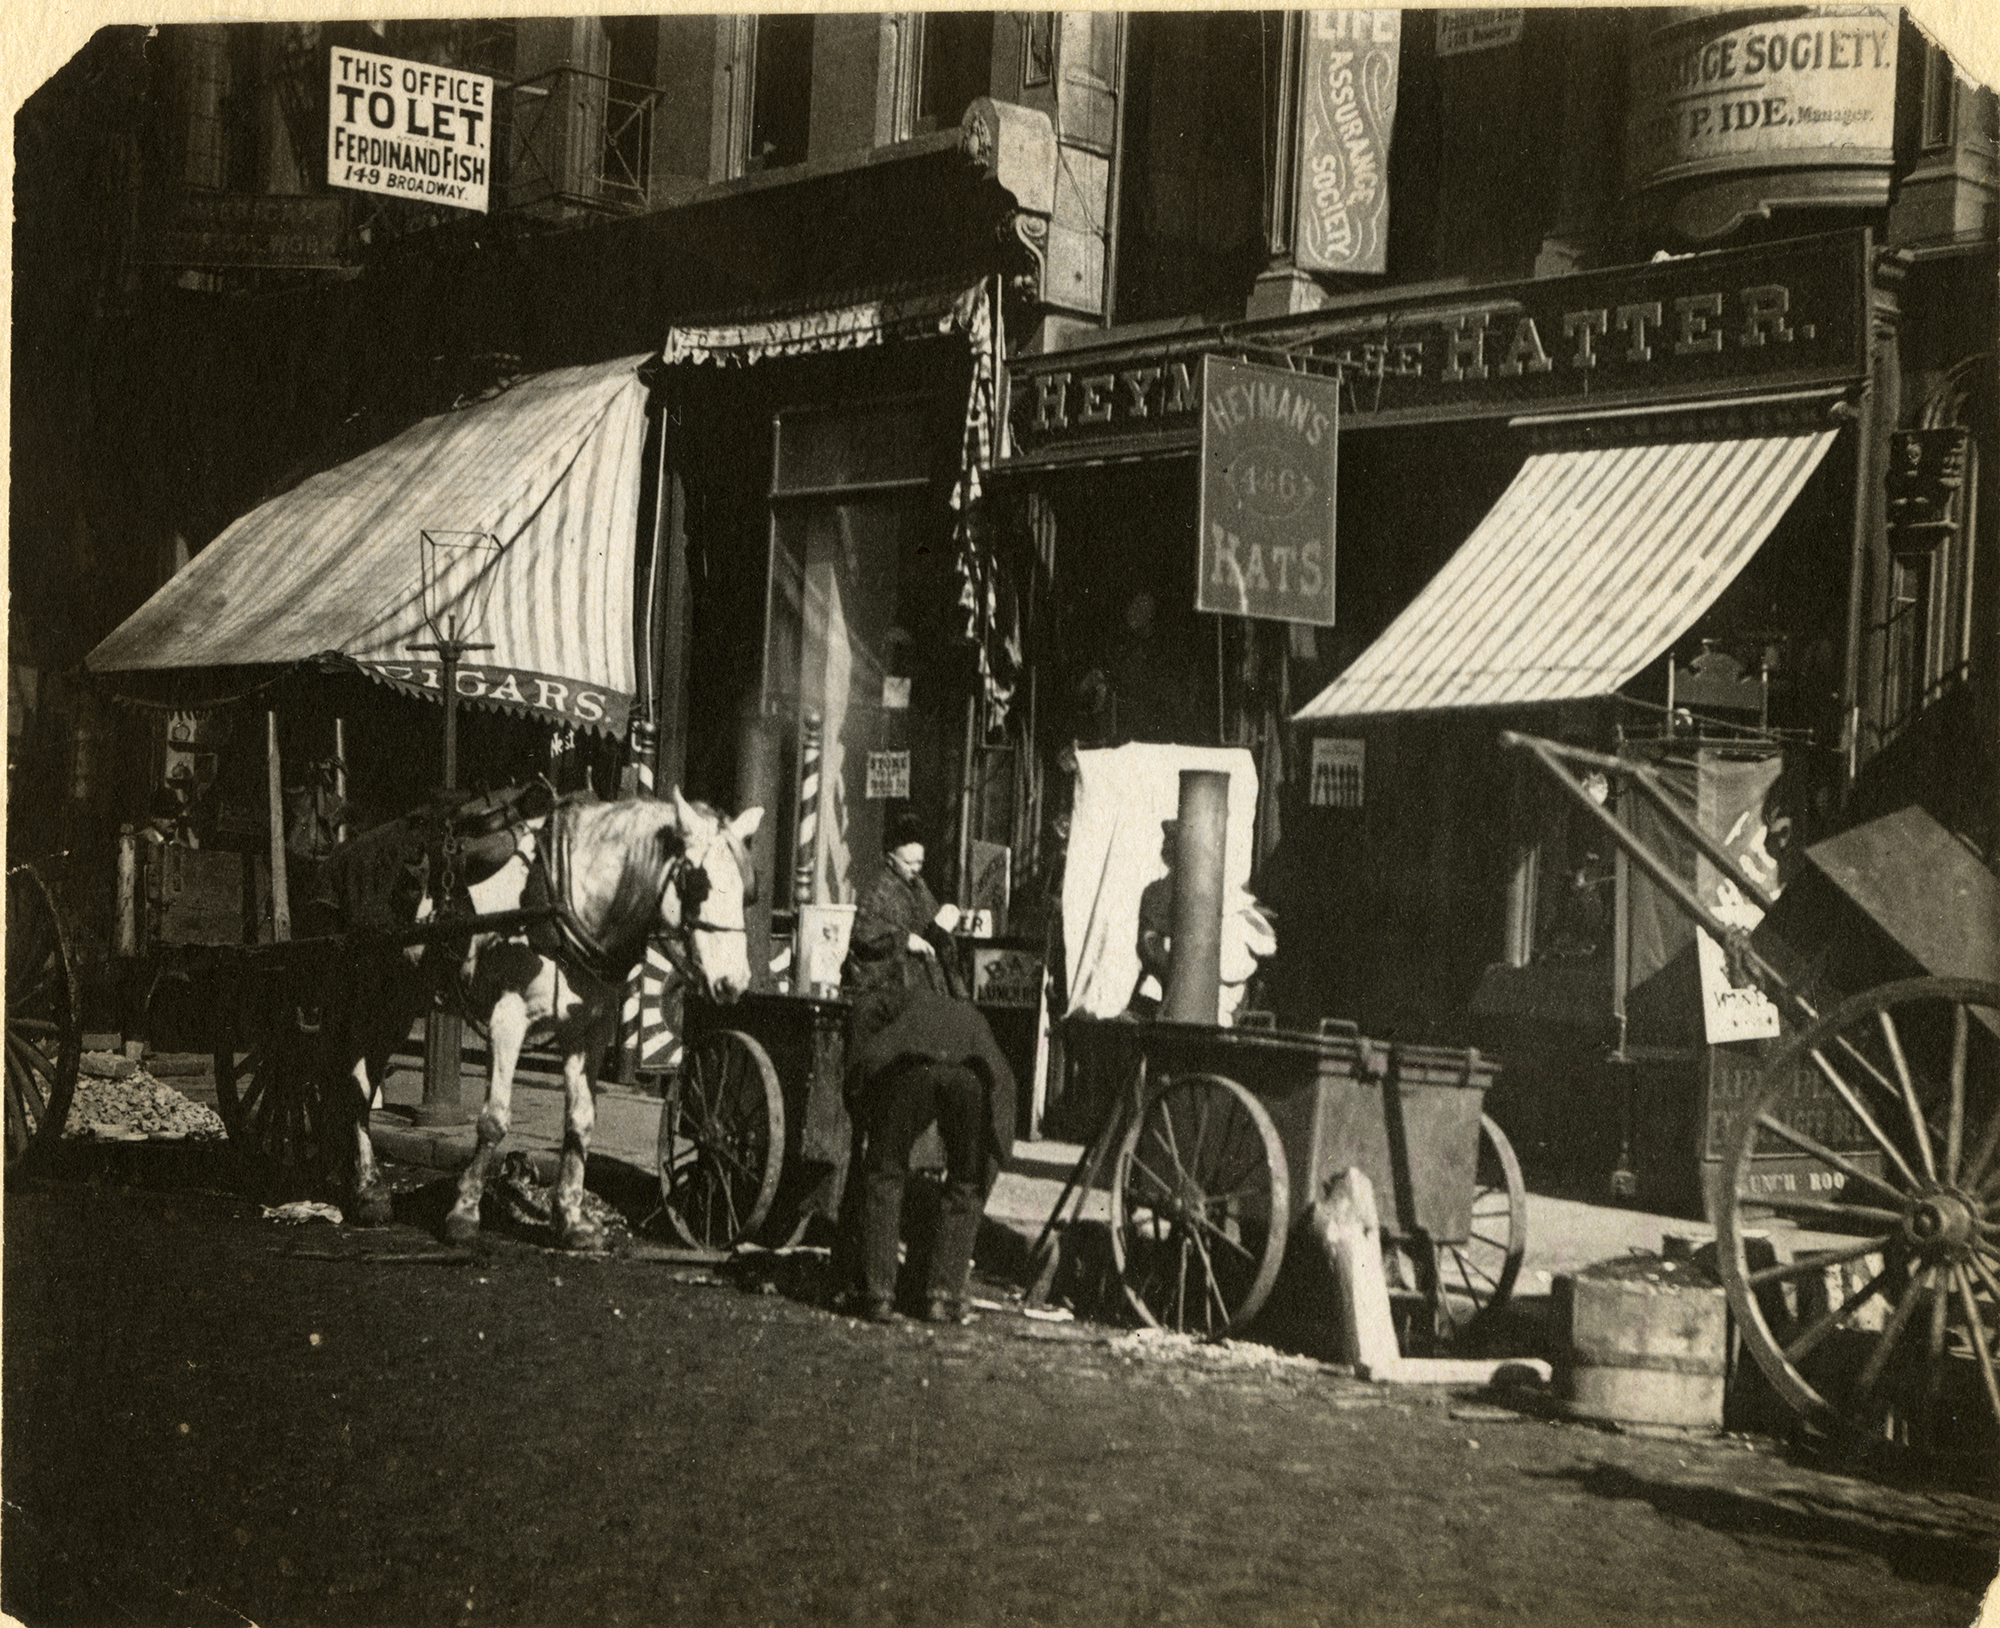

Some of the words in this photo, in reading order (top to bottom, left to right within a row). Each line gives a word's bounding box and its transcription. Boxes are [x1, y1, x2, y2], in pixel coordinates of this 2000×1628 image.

[338, 55, 393, 88] THIS
[402, 68, 485, 107] OFFICE
[1744, 29, 1891, 76] SOCIETY.
[336, 84, 395, 129] TO
[406, 98, 485, 149] LET.
[1328, 51, 1379, 206] ASSURANCE
[335, 126, 440, 177] FERDINAND
[443, 146, 485, 185] FISH
[344, 165, 381, 185] 149
[386, 173, 468, 201] BROADWAY.
[1311, 153, 1351, 258] SOCIETY
[1441, 284, 1815, 382] HATTER.
[1748, 1172, 1797, 1192] UNCH
